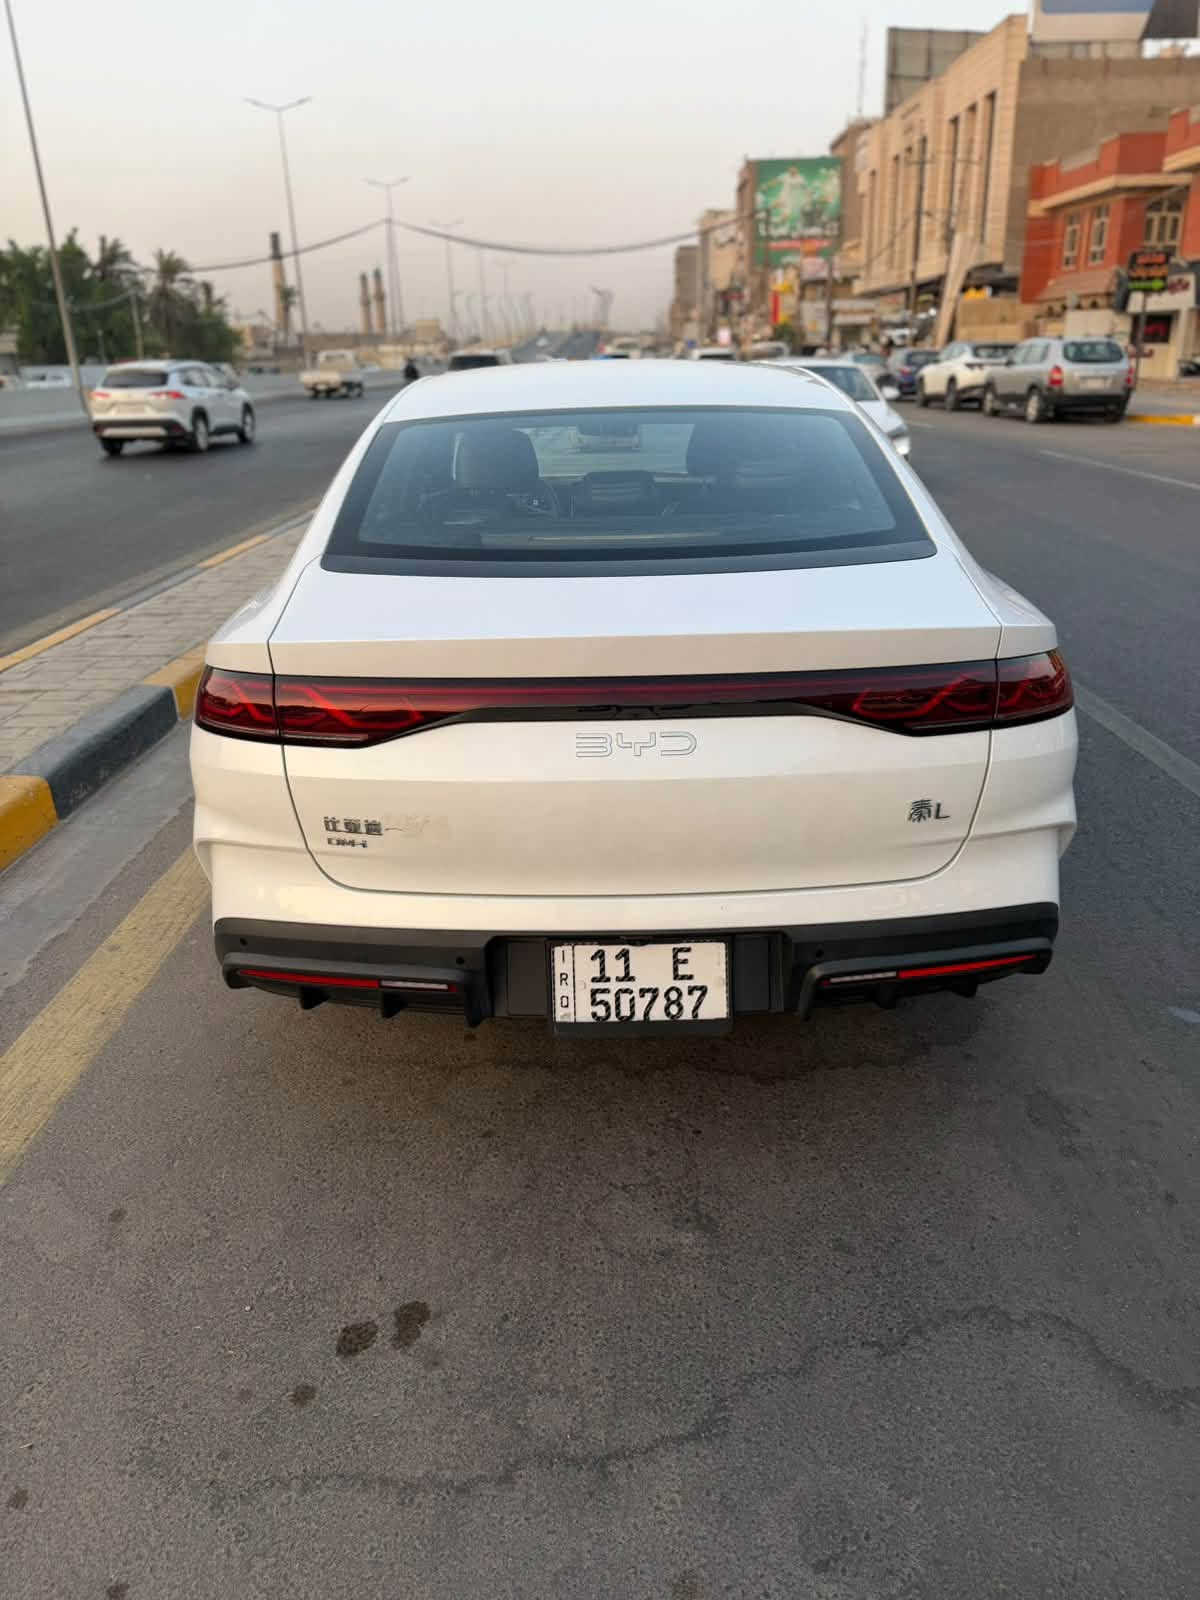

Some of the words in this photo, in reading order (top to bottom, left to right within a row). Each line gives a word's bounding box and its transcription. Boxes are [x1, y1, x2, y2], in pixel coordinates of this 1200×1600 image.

[575, 731, 698, 758] BYD
[590, 948, 636, 983] 11
[672, 947, 694, 981] E
[590, 985, 708, 1022] 50787
